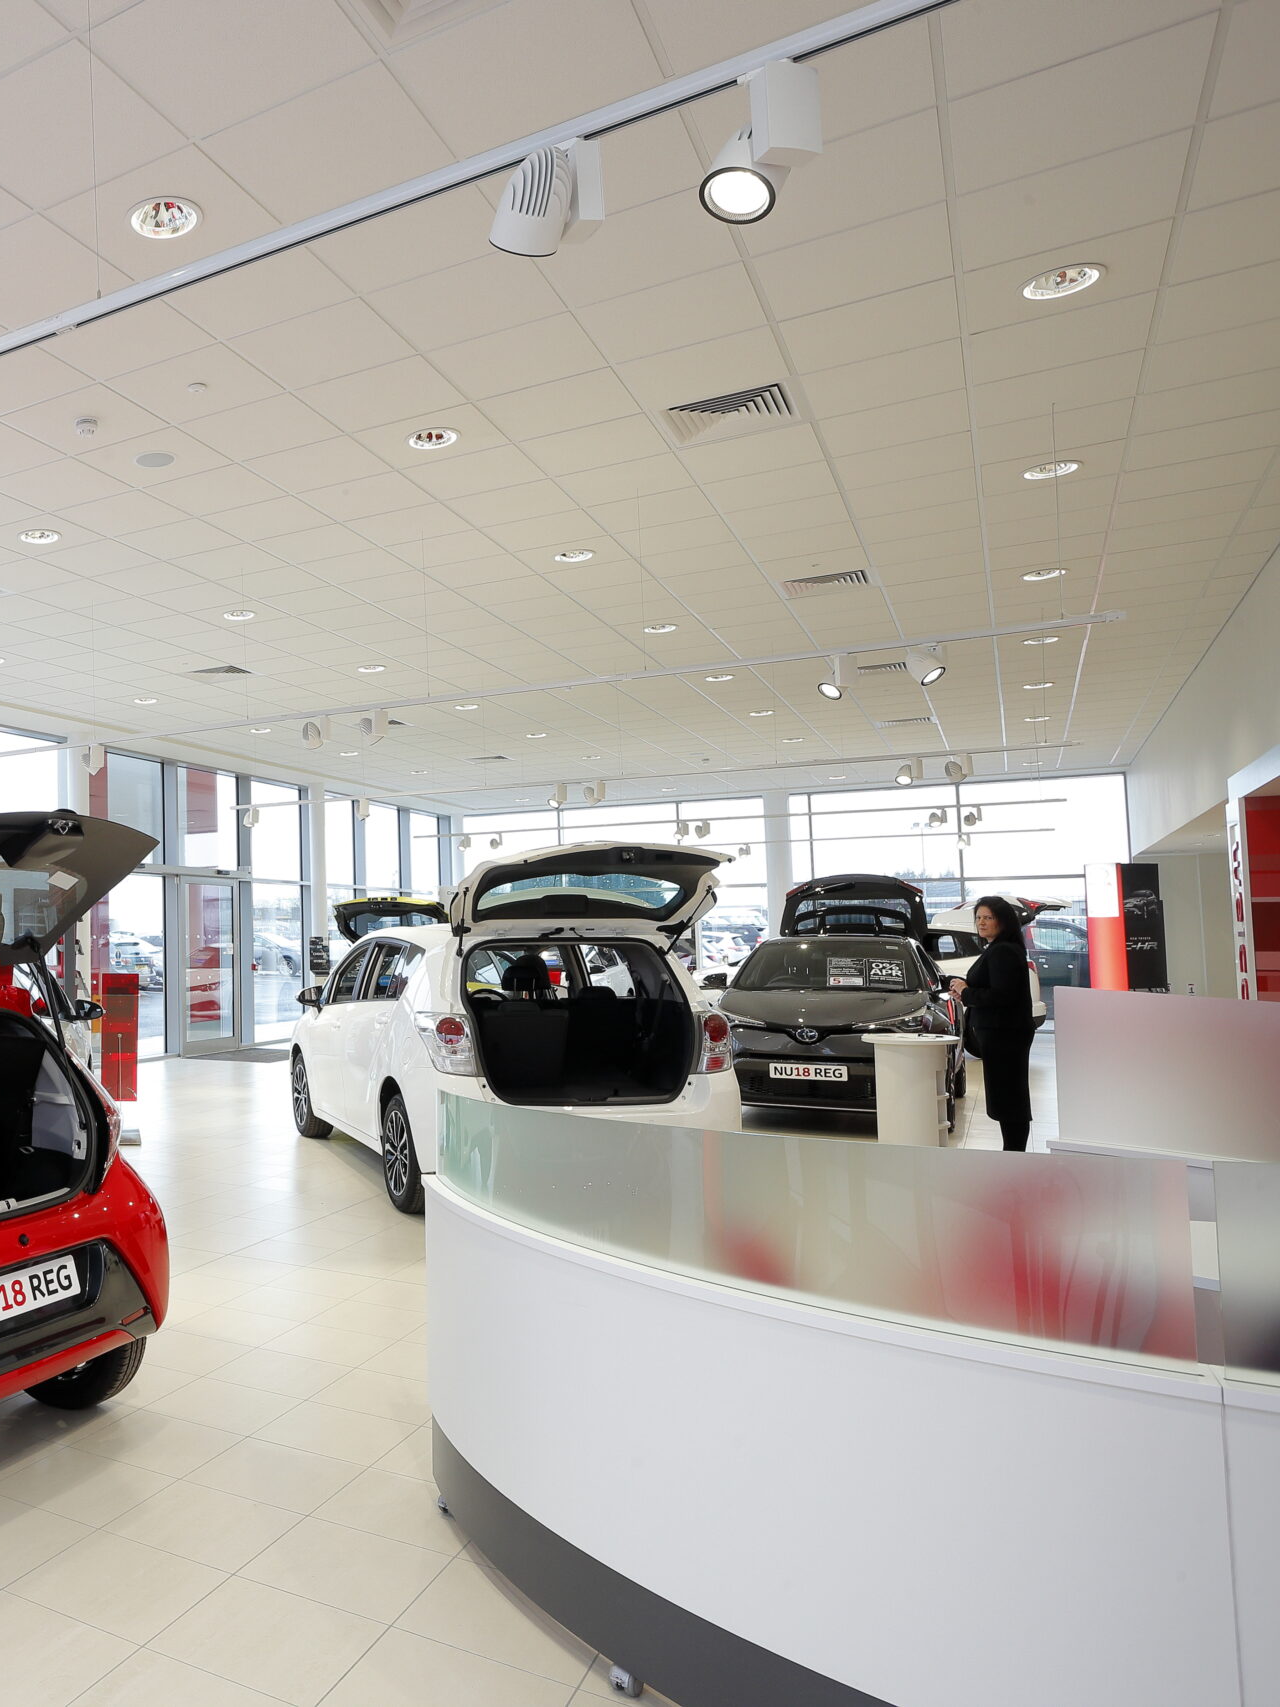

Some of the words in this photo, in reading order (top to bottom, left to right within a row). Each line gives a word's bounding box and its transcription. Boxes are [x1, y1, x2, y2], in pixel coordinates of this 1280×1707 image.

[871, 963, 899, 971] 0%
[870, 969, 903, 977] APR
[774, 1066, 810, 1077] NU18
[814, 1068, 843, 1078] REG
[28, 1264, 73, 1301] REG
